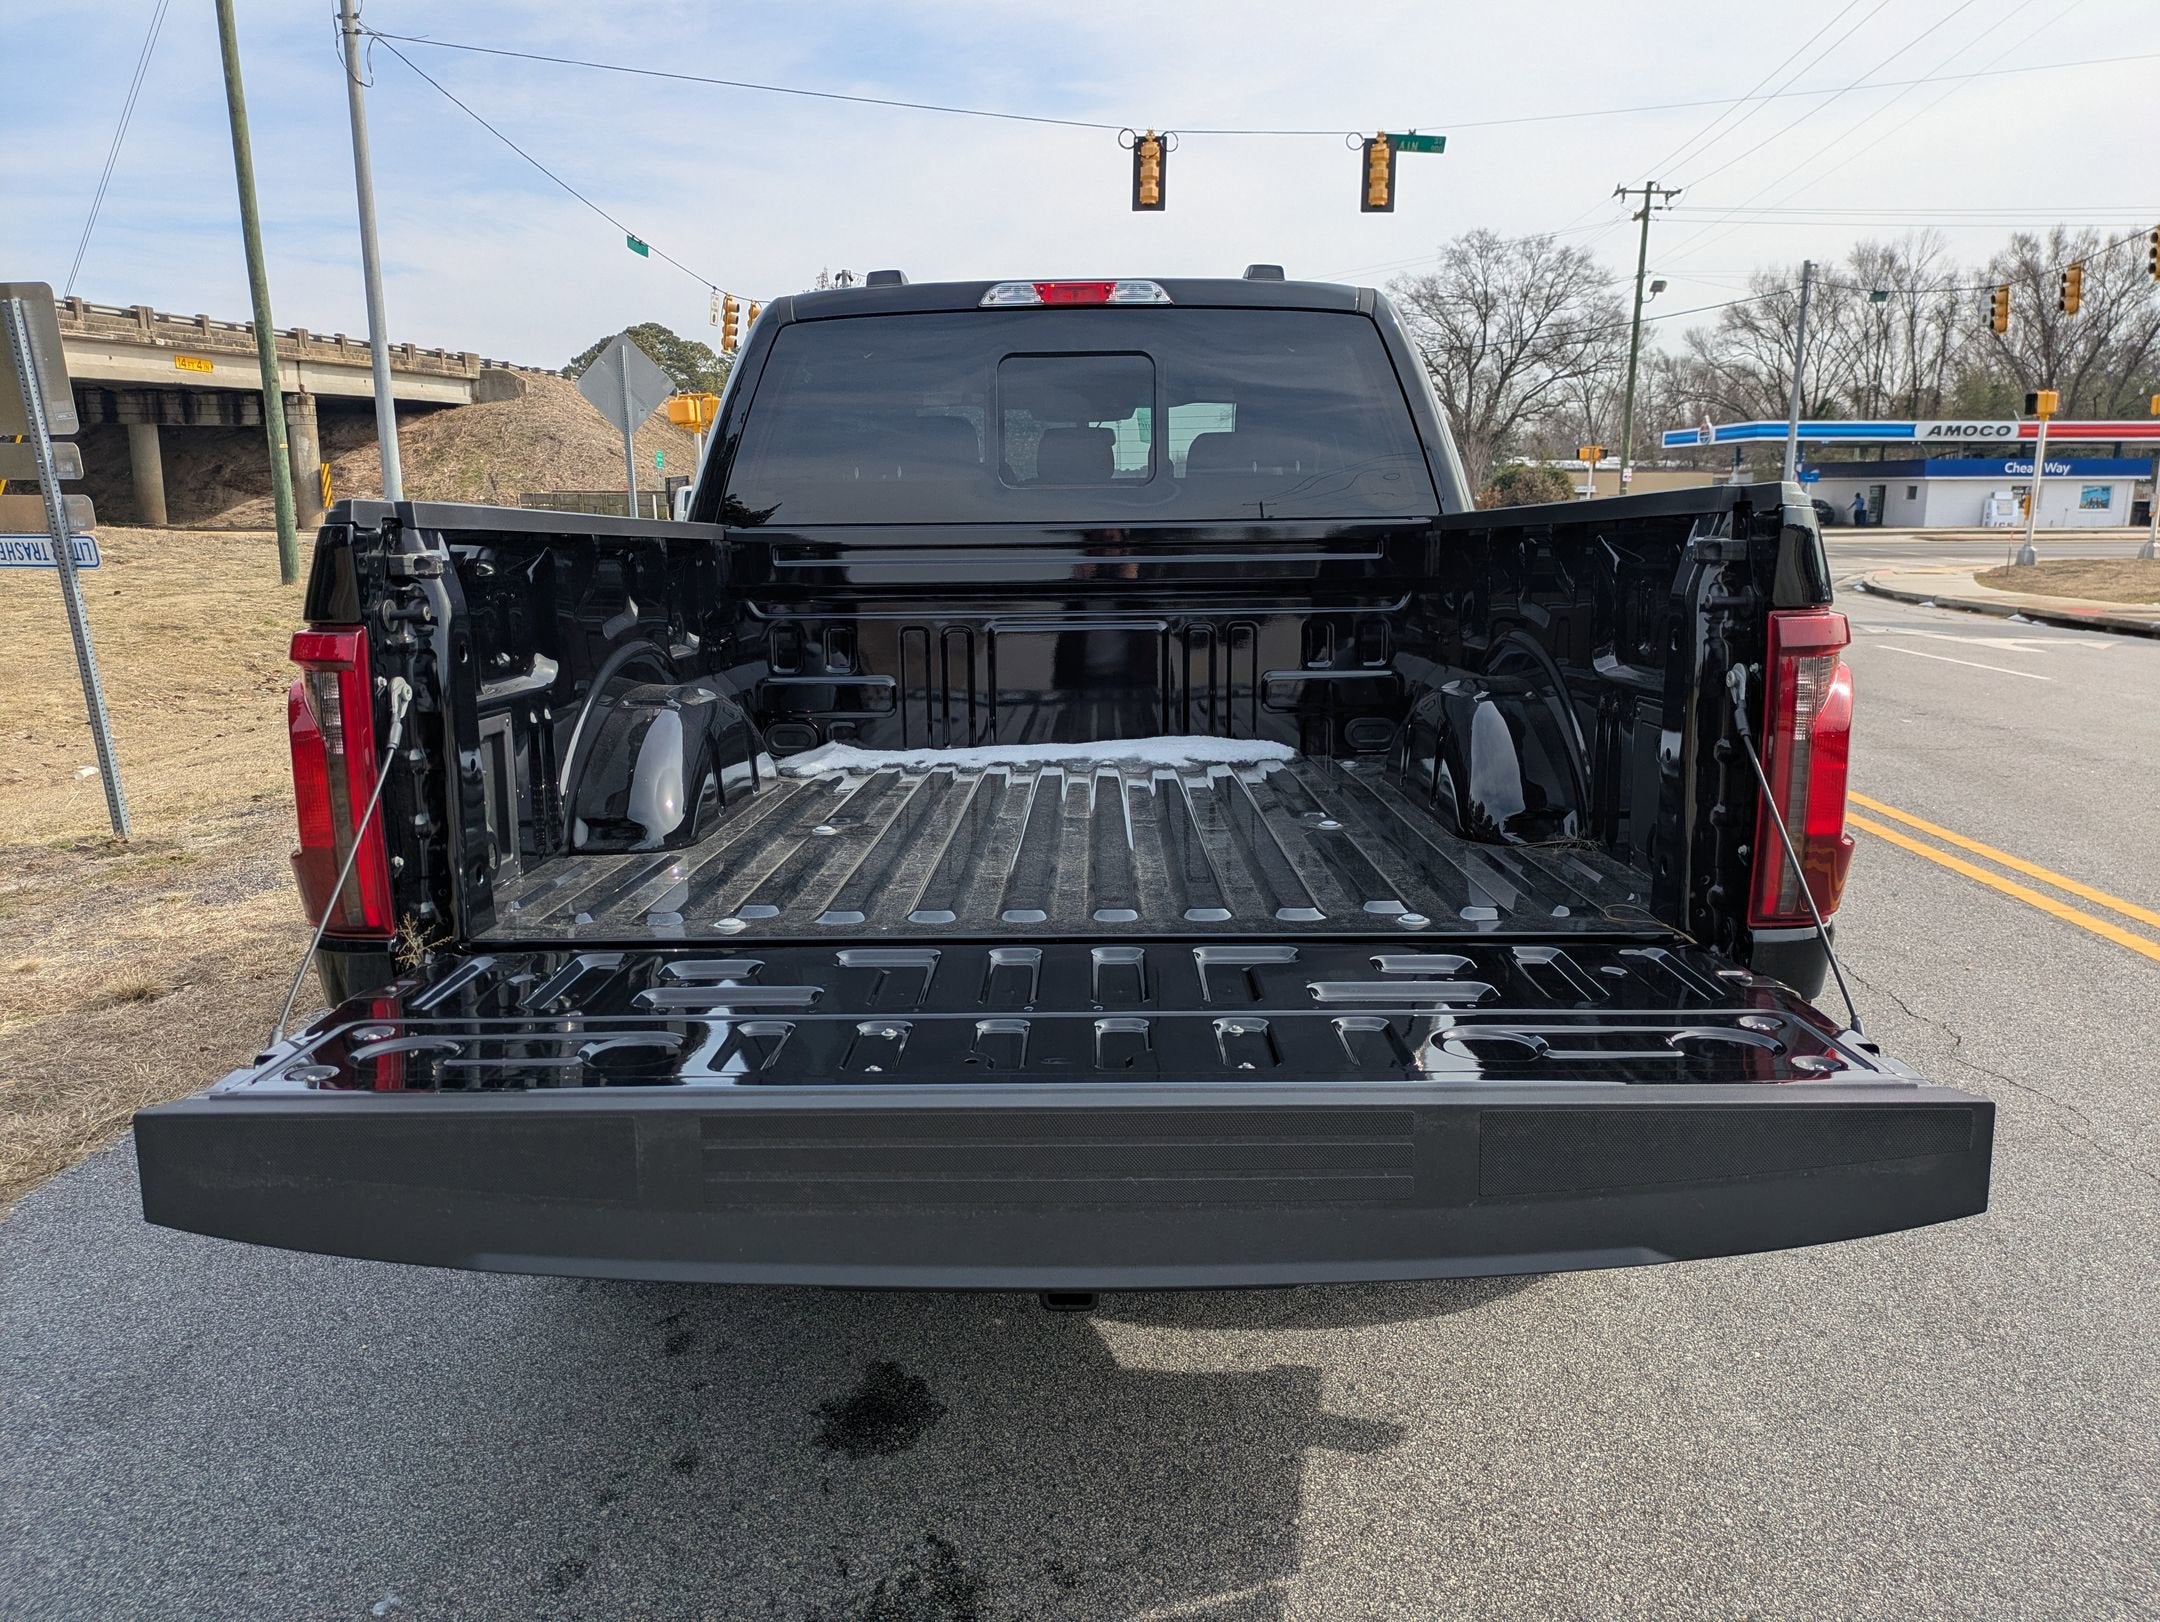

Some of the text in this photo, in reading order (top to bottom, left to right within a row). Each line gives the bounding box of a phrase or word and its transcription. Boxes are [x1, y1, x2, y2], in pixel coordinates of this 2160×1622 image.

[177, 357, 187, 368] 14
[1927, 425, 2012, 437] AMOCO
[2004, 462, 2072, 476] Chea Way
